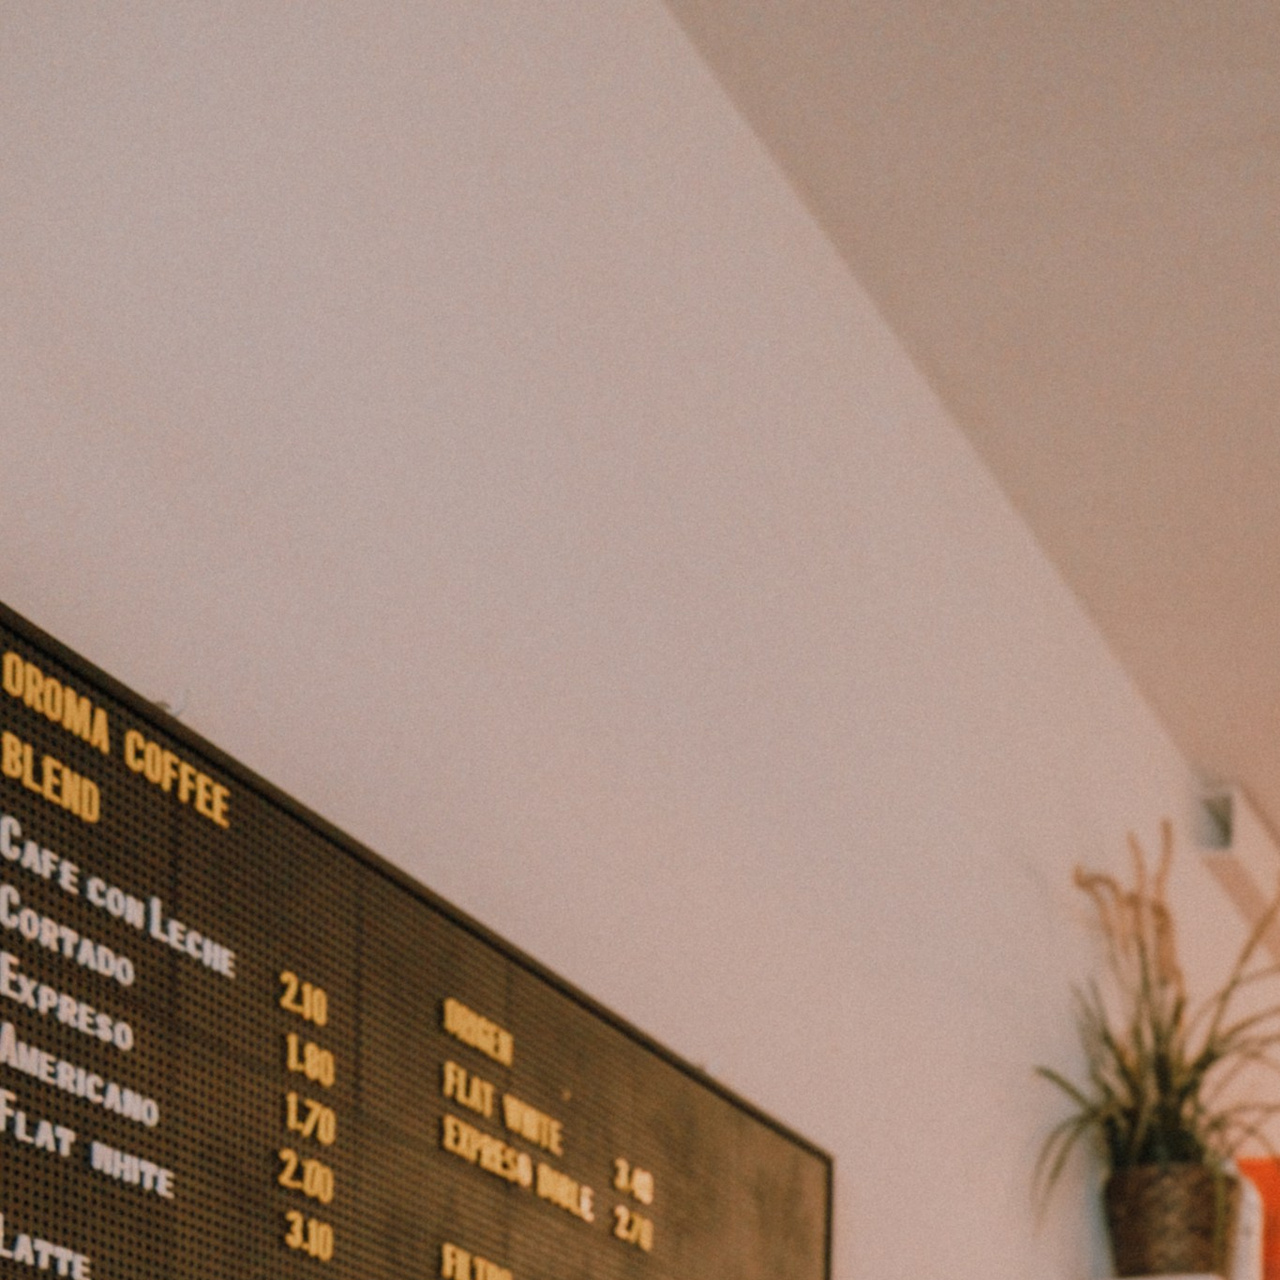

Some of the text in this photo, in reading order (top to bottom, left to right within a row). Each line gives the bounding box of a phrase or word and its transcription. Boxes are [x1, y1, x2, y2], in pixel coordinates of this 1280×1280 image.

[2, 731, 100, 823] BLEND
[3, 651, 230, 828] OROMA COFFEE
[0, 816, 236, 979] CAFE CON LECHE
[0, 884, 136, 987] CORTADO
[0, 951, 135, 1052] EXPRESO
[0, 1021, 160, 1128] AMERICANO
[286, 1091, 337, 1146] 1.70
[443, 1060, 565, 1157] FLAT WHITE
[0, 1088, 176, 1200] FLAT WHITE
[285, 1210, 335, 1263] 3.10
